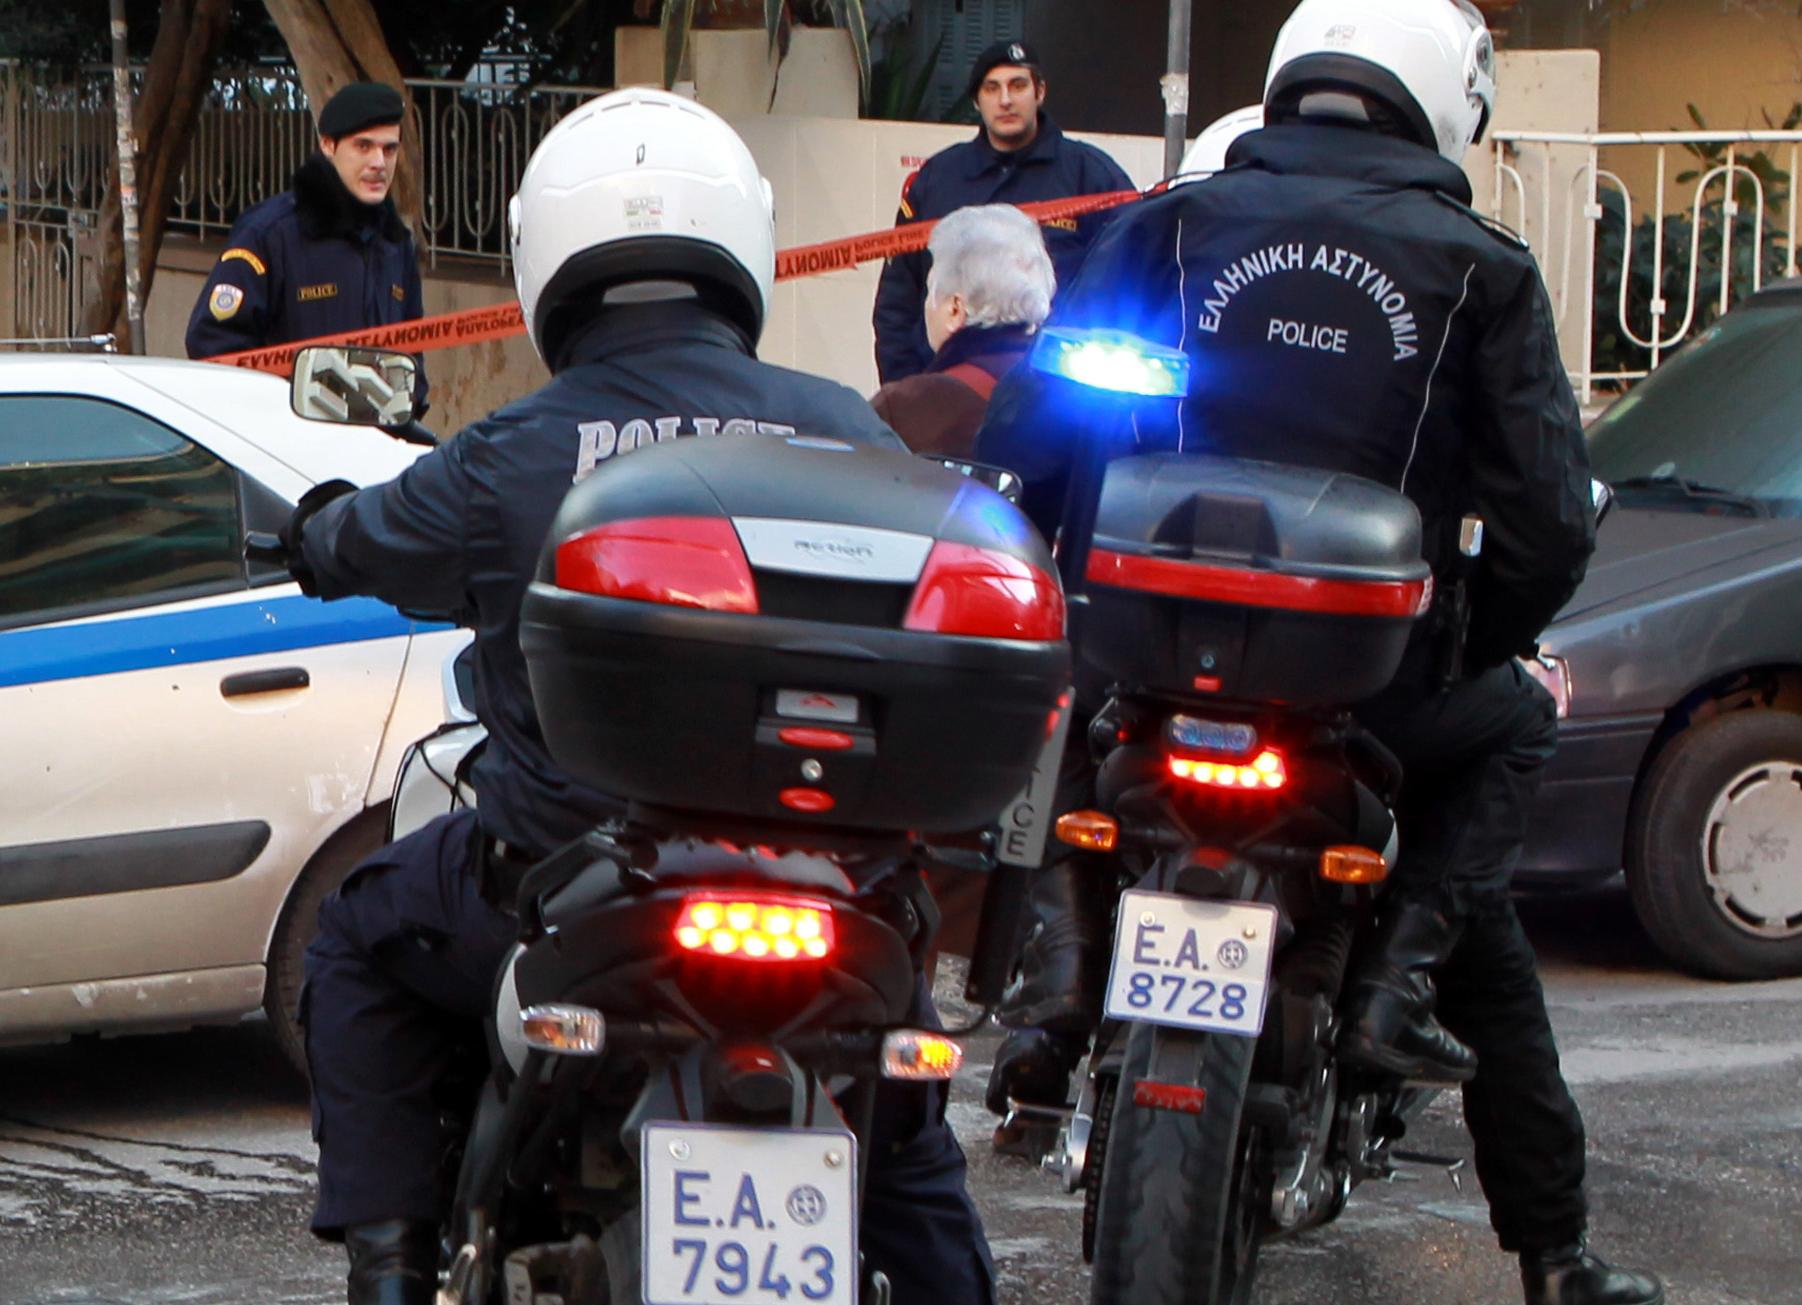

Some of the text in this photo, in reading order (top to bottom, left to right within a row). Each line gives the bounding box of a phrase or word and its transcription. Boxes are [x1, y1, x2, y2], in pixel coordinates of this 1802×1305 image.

[1199, 243, 1418, 361] ΕΛΛΗΝΙΚΗ ΑΣΤΥΝΟΜΙΑ
[1267, 318, 1349, 353] POLICE
[1007, 768, 1040, 856] ICE
[1127, 972, 1247, 1020] 8728
[673, 1238, 834, 1300] 7943
